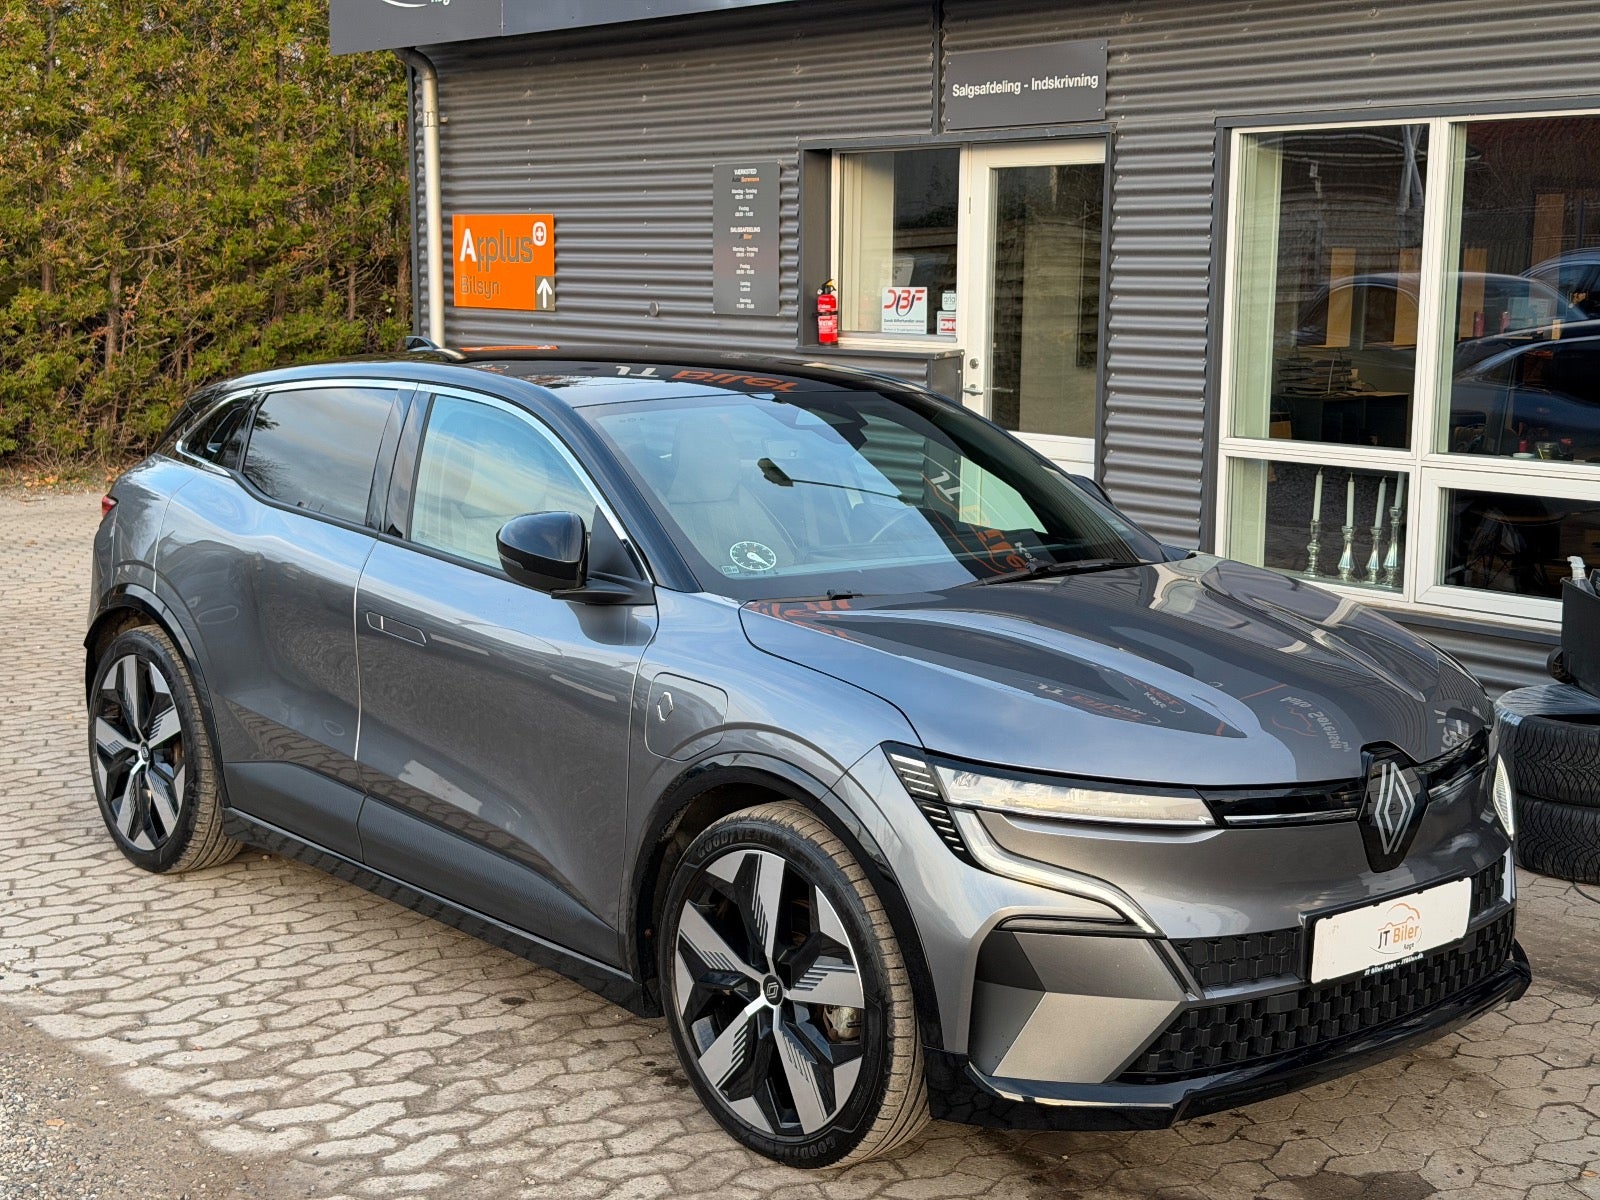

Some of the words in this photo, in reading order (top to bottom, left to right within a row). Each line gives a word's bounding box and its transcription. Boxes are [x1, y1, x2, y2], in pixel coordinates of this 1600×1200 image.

[952, 80, 1021, 98] Salgsafdeling
[1031, 73, 1099, 91] Indskrivning
[460, 275, 500, 299] Bilsyn
[1378, 930, 1390, 949] JT
[1393, 925, 1419, 943] Biler
